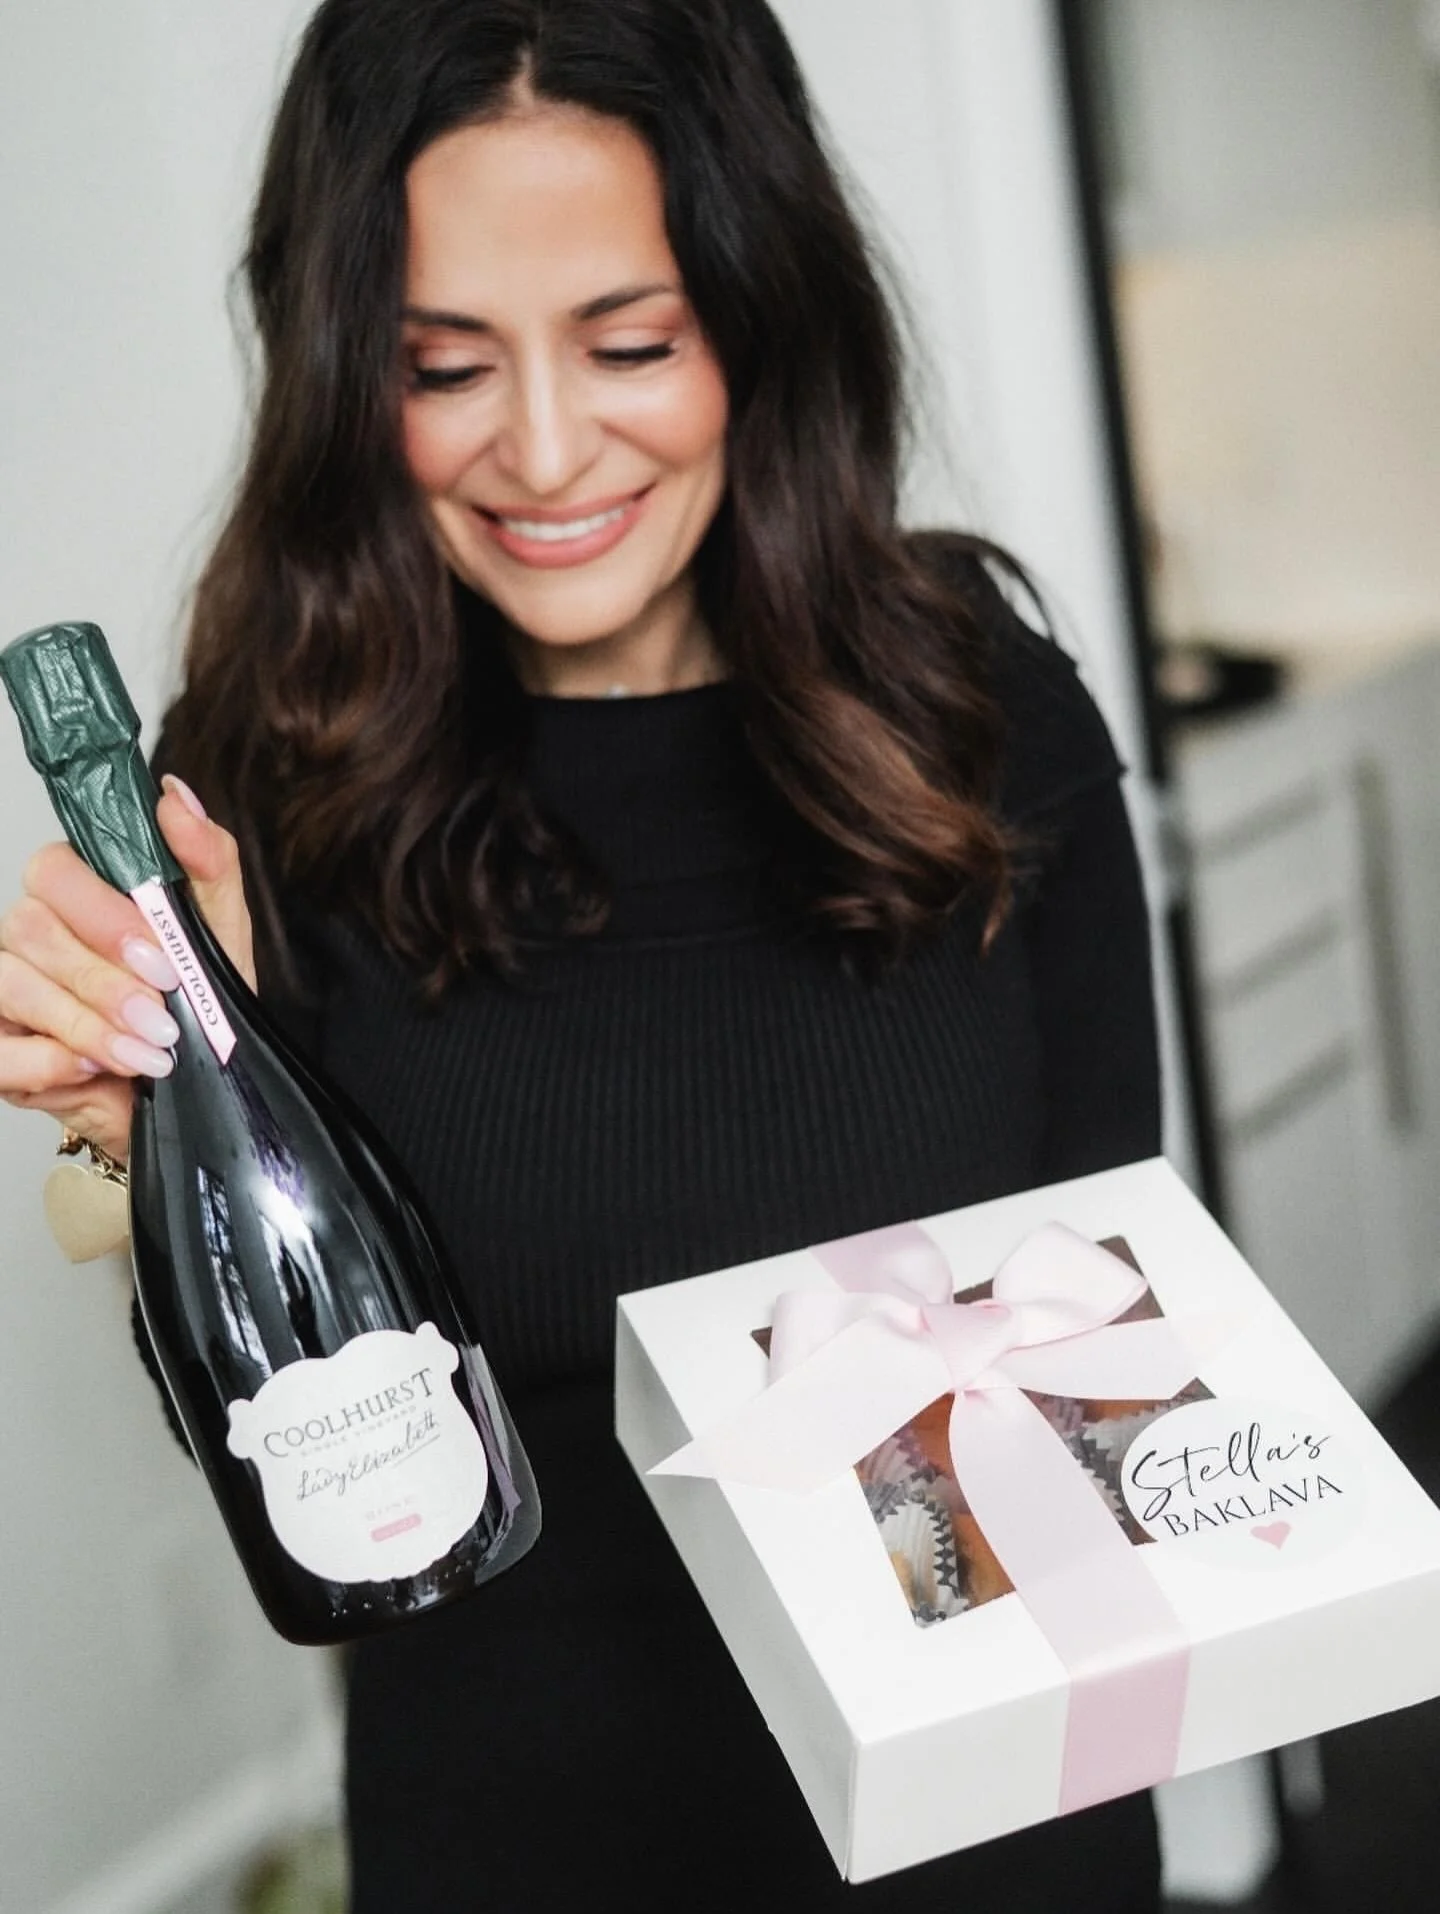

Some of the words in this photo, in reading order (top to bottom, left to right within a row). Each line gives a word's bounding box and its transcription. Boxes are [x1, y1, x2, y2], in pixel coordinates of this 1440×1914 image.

[150, 908, 219, 1026] COOLHURST
[263, 1367, 433, 1458] COOLHURST
[1131, 1422, 1332, 1521] Stella's
[1162, 1474, 1343, 1536] BAKLAVA
